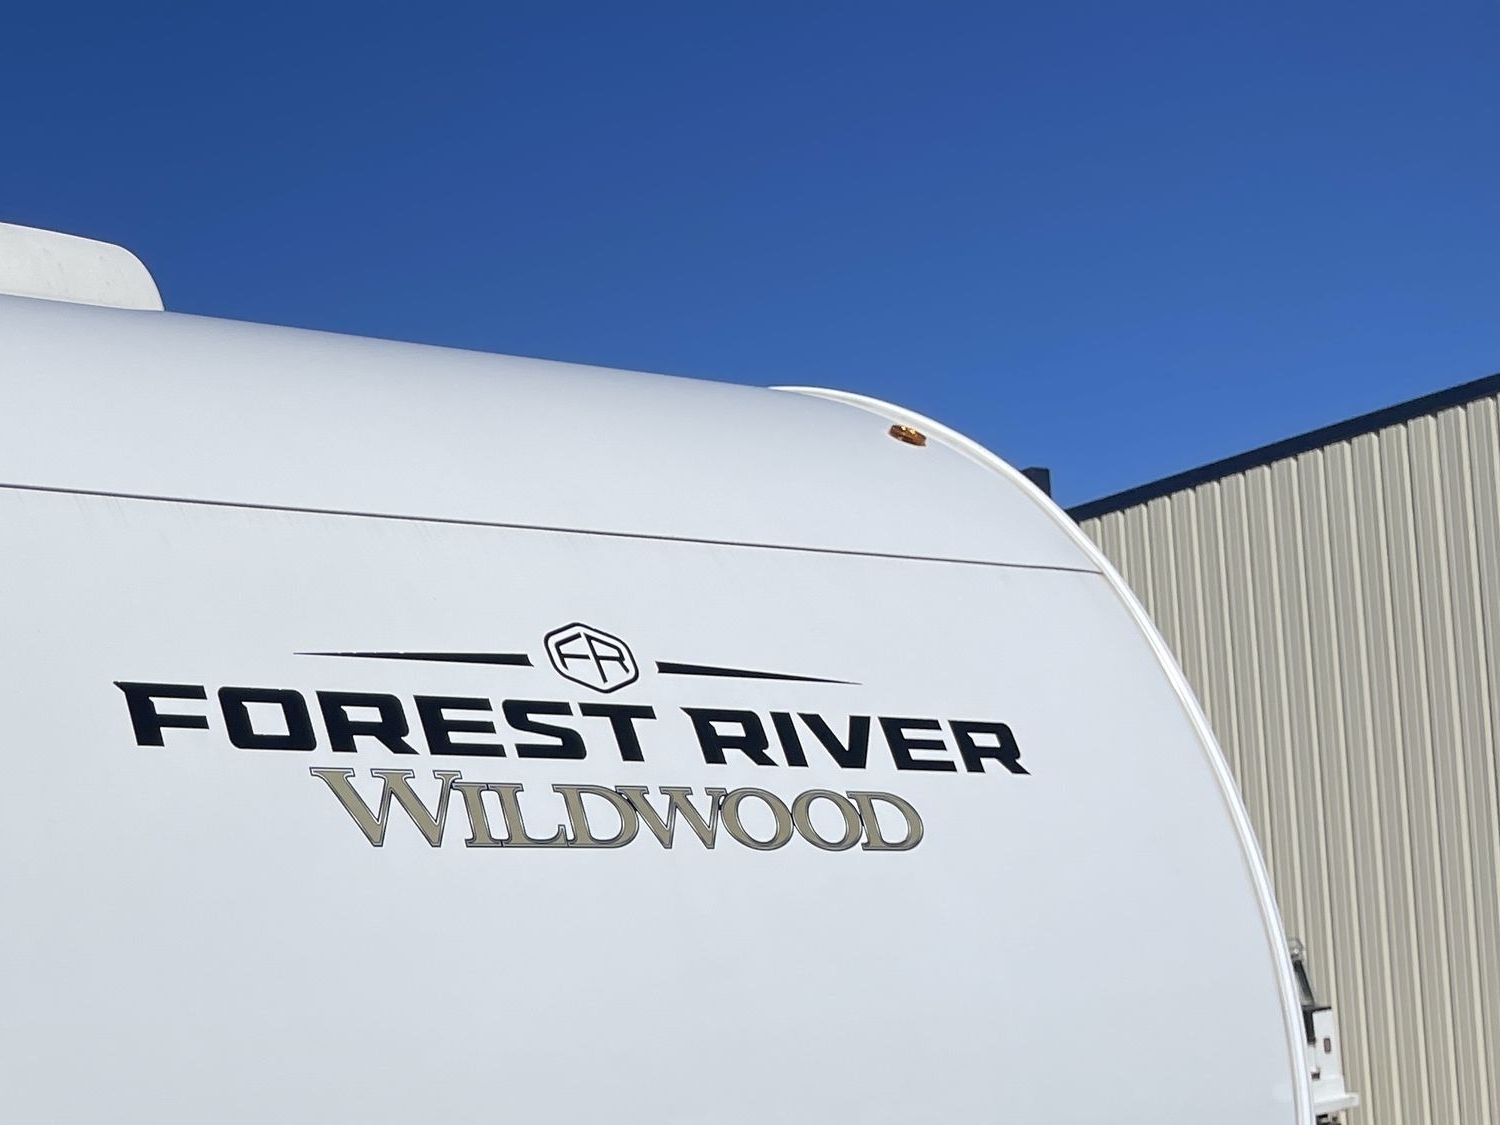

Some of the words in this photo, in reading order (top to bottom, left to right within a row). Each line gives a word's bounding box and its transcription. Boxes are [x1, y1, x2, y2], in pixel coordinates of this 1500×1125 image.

[553, 631, 632, 685] FR
[113, 681, 657, 762] FOREST
[680, 707, 1031, 776] RIVER
[309, 766, 924, 851] WILDWOOD
